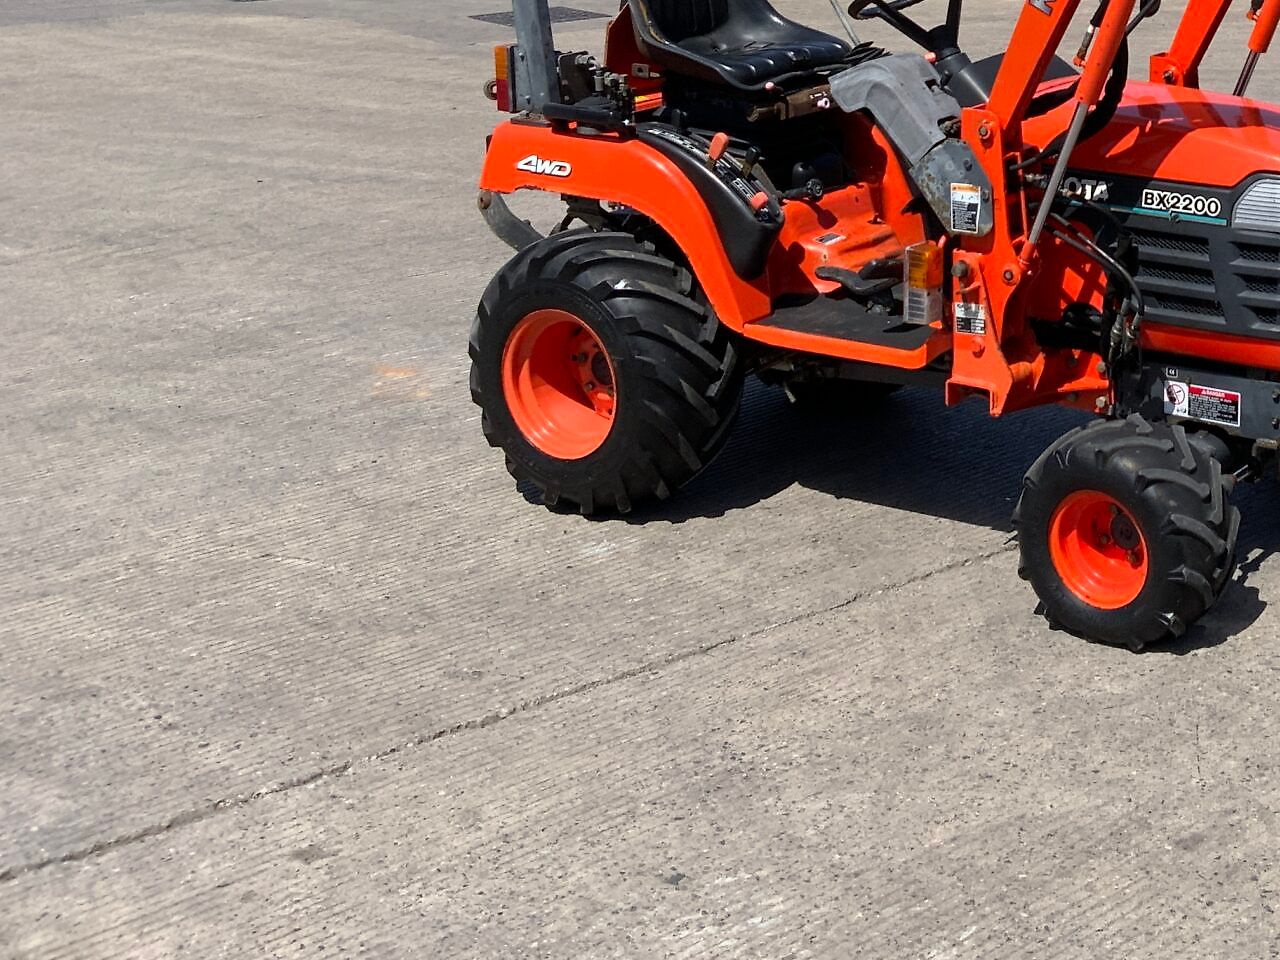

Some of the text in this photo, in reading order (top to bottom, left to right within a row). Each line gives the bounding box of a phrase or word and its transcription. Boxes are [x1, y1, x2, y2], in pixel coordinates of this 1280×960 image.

[516, 153, 573, 177] 4WD
[1062, 176, 1110, 201] OTA
[1141, 188, 1222, 217] BX2200
